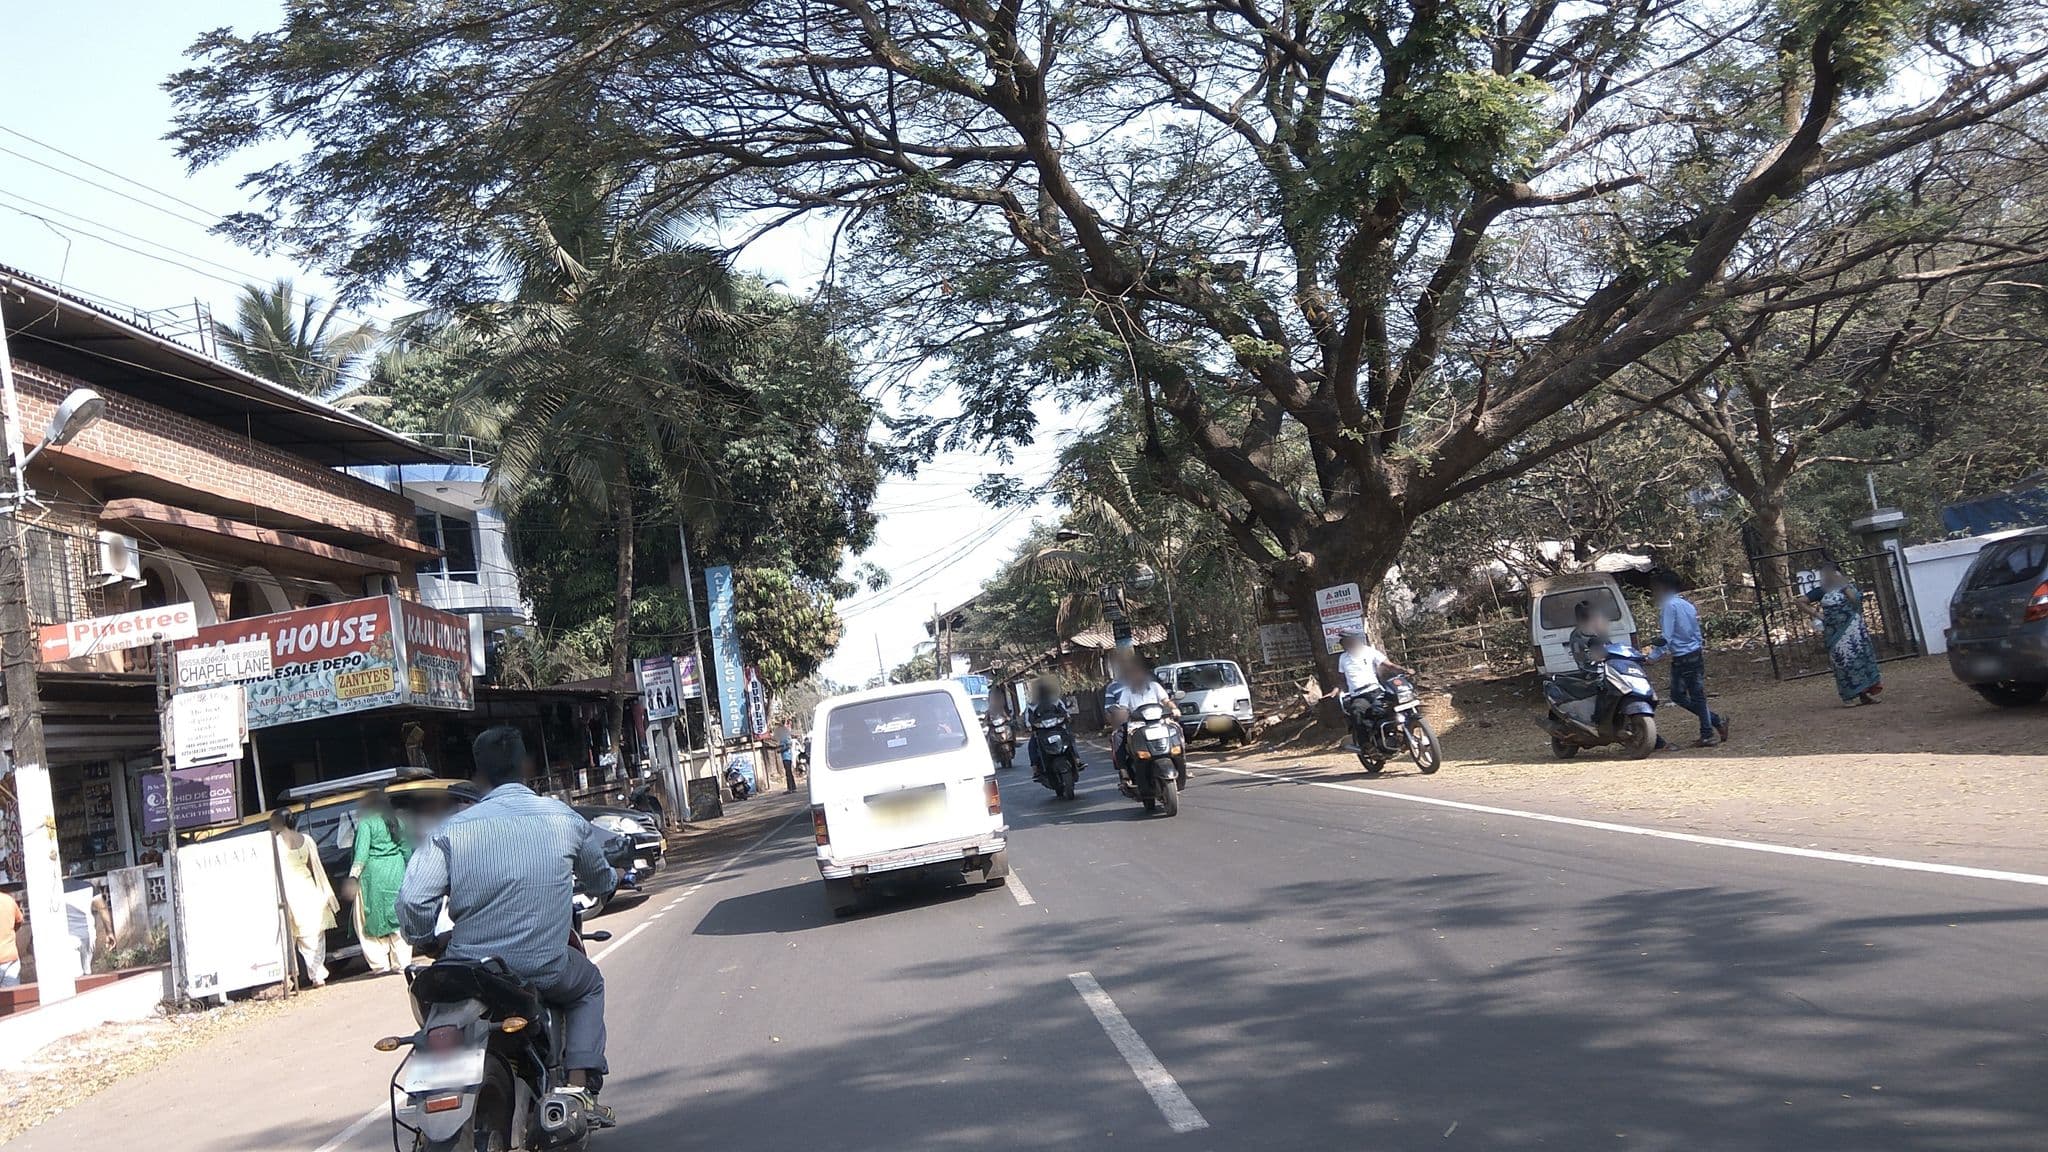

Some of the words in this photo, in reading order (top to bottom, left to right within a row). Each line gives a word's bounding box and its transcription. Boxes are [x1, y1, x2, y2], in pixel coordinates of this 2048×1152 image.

[1333, 588, 1351, 598] atul
[73, 611, 190, 641] Pinetree
[276, 613, 378, 656] HOUSE
[407, 613, 434, 647] KAJU
[436, 622, 468, 654] HOUSE
[180, 662, 231, 682] CHAPEL
[237, 657, 270, 675] LANE
[323, 655, 362, 672] DEPO
[339, 668, 390, 688] ZANTYE'S
[259, 692, 305, 707] APPROVED
[306, 689, 330, 700] SHOP
[344, 686, 370, 697] CASHEW
[371, 683, 388, 693] NUTS
[209, 787, 231, 797] GOA
[198, 808, 215, 816] THIS
[216, 806, 232, 814] WAY
